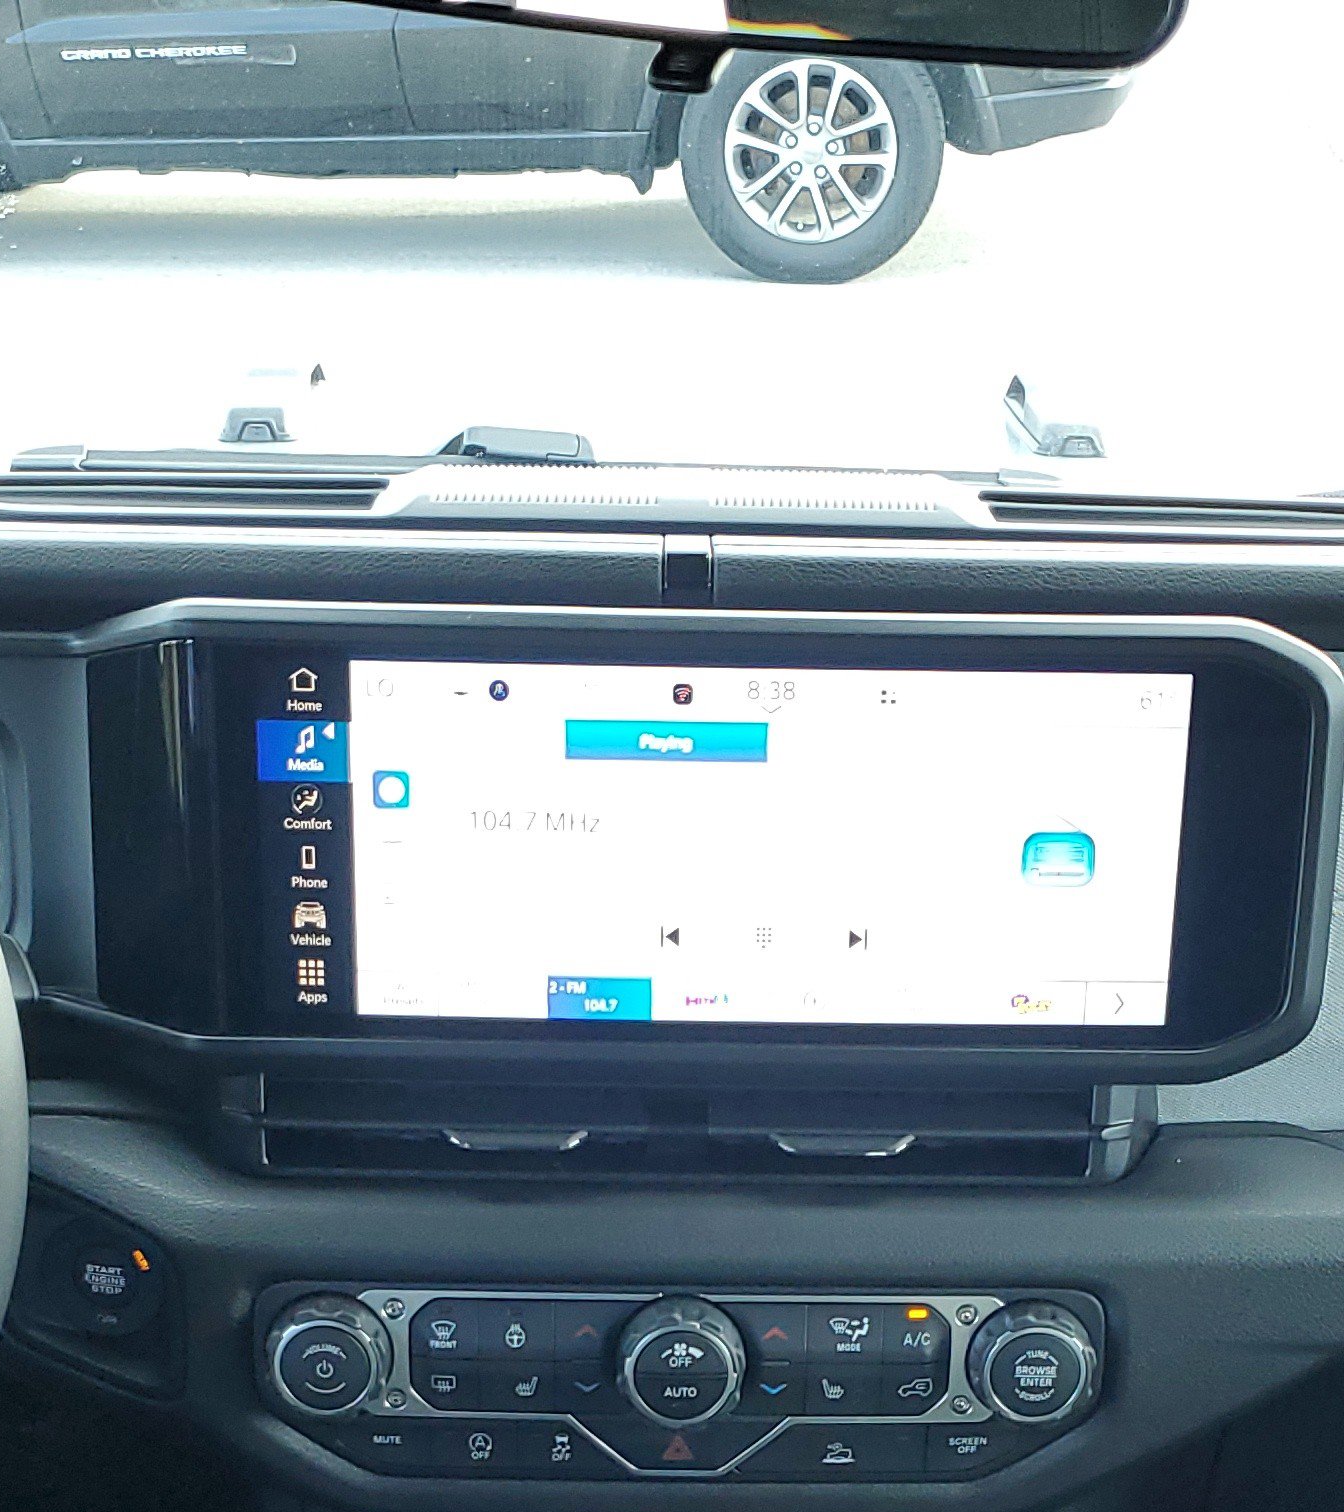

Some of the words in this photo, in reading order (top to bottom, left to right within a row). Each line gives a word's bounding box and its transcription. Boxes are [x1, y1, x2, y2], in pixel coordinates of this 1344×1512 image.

[60, 48, 132, 61] GRAND
[134, 44, 247, 59] CHEROKEE
[286, 698, 323, 713] Home
[287, 757, 324, 772] Media
[283, 816, 333, 831] Comfort
[291, 875, 328, 890] Phone
[290, 932, 332, 947] Vehicle
[298, 991, 328, 1005] Apps
[86, 1264, 124, 1275] START
[85, 1274, 126, 1286] ENGINE
[91, 1284, 123, 1295] STOP
[903, 1331, 931, 1347] A/C
[836, 1342, 861, 1353] MODE
[668, 1355, 693, 1369] OFF
[1015, 1364, 1057, 1376] BROWSE
[1019, 1376, 1053, 1388] ENTER
[664, 1386, 698, 1399] AUTO
[373, 1434, 403, 1446] MUTE
[949, 1436, 988, 1446] SCREEN
[471, 1449, 490, 1461] OFF
[957, 1445, 977, 1455] OFF
